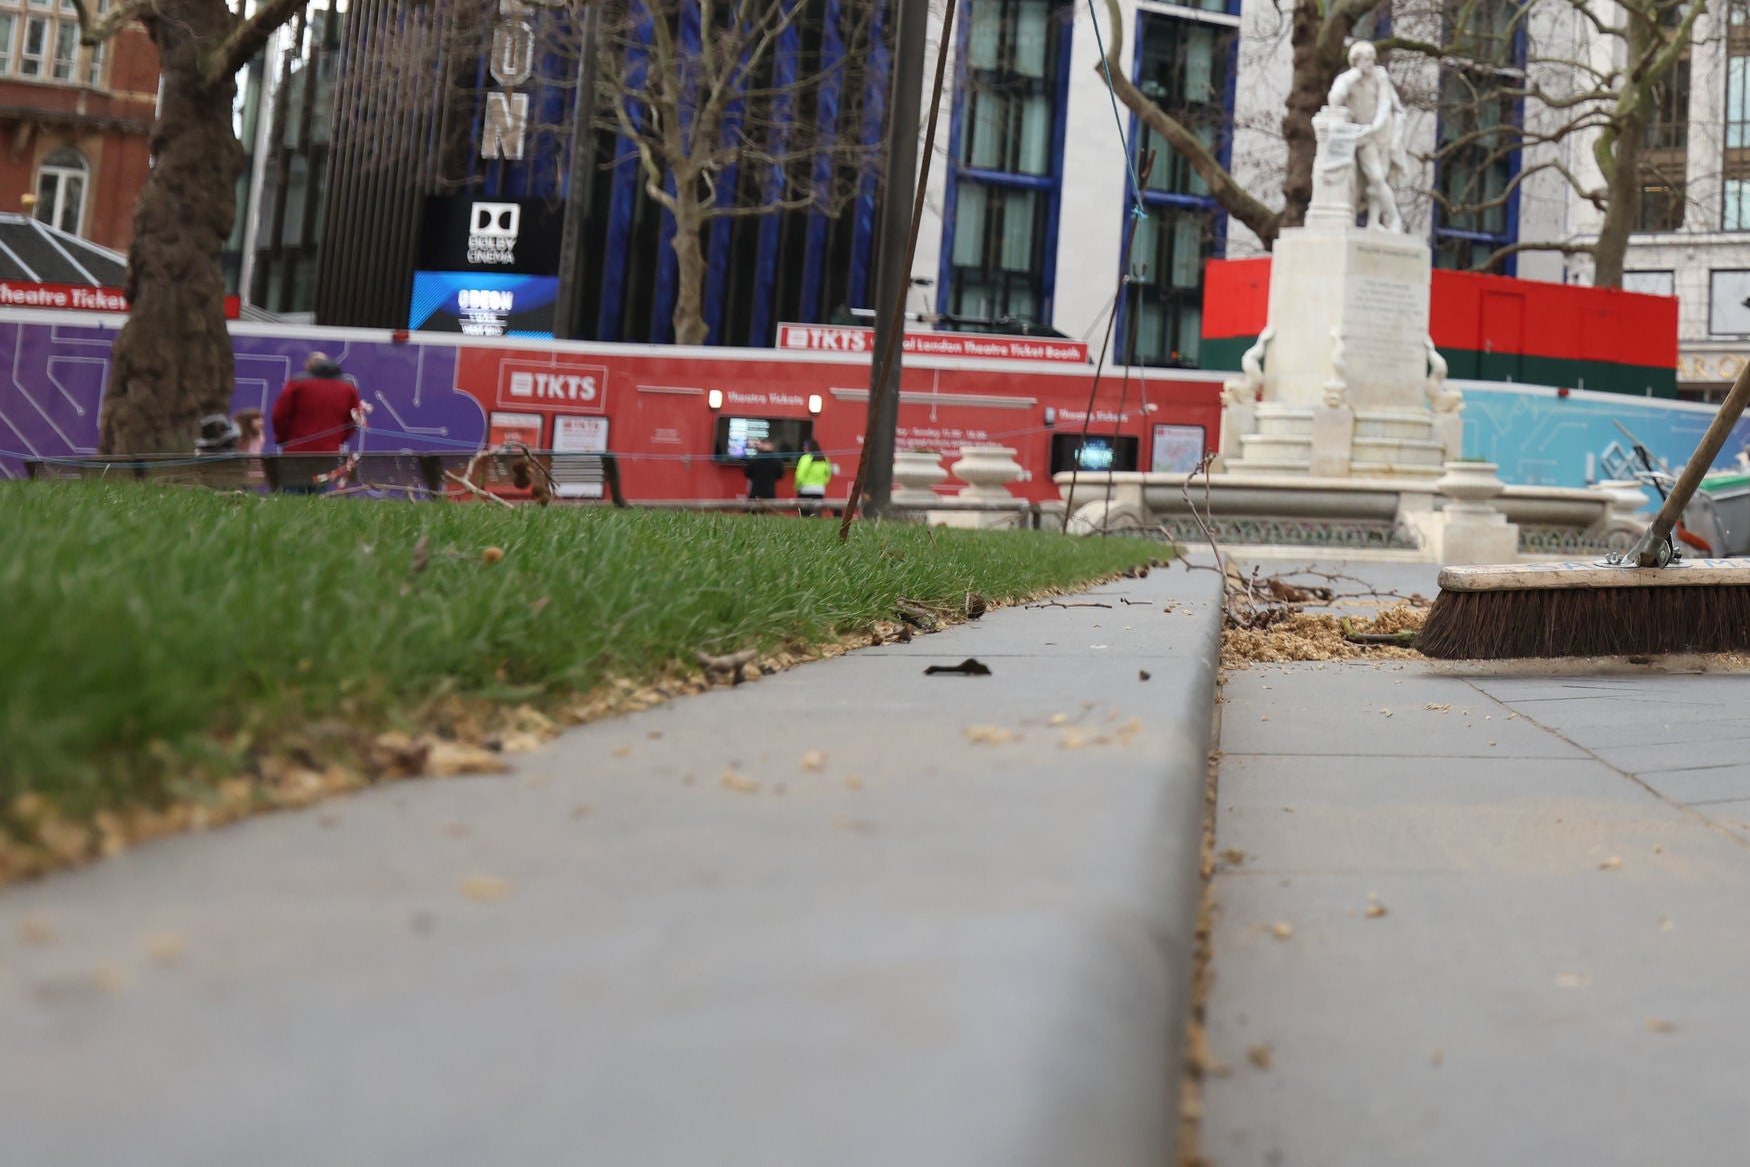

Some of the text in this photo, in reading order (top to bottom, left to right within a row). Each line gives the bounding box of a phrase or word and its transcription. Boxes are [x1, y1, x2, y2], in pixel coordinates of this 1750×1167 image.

[467, 234, 517, 250] DOLBY
[466, 248, 515, 265] CINEMA
[0, 283, 67, 306] heatre
[458, 289, 514, 311] ODEON
[807, 329, 865, 352] TKTS
[964, 340, 1009, 357] Theatre
[534, 373, 596, 401] TKTS
